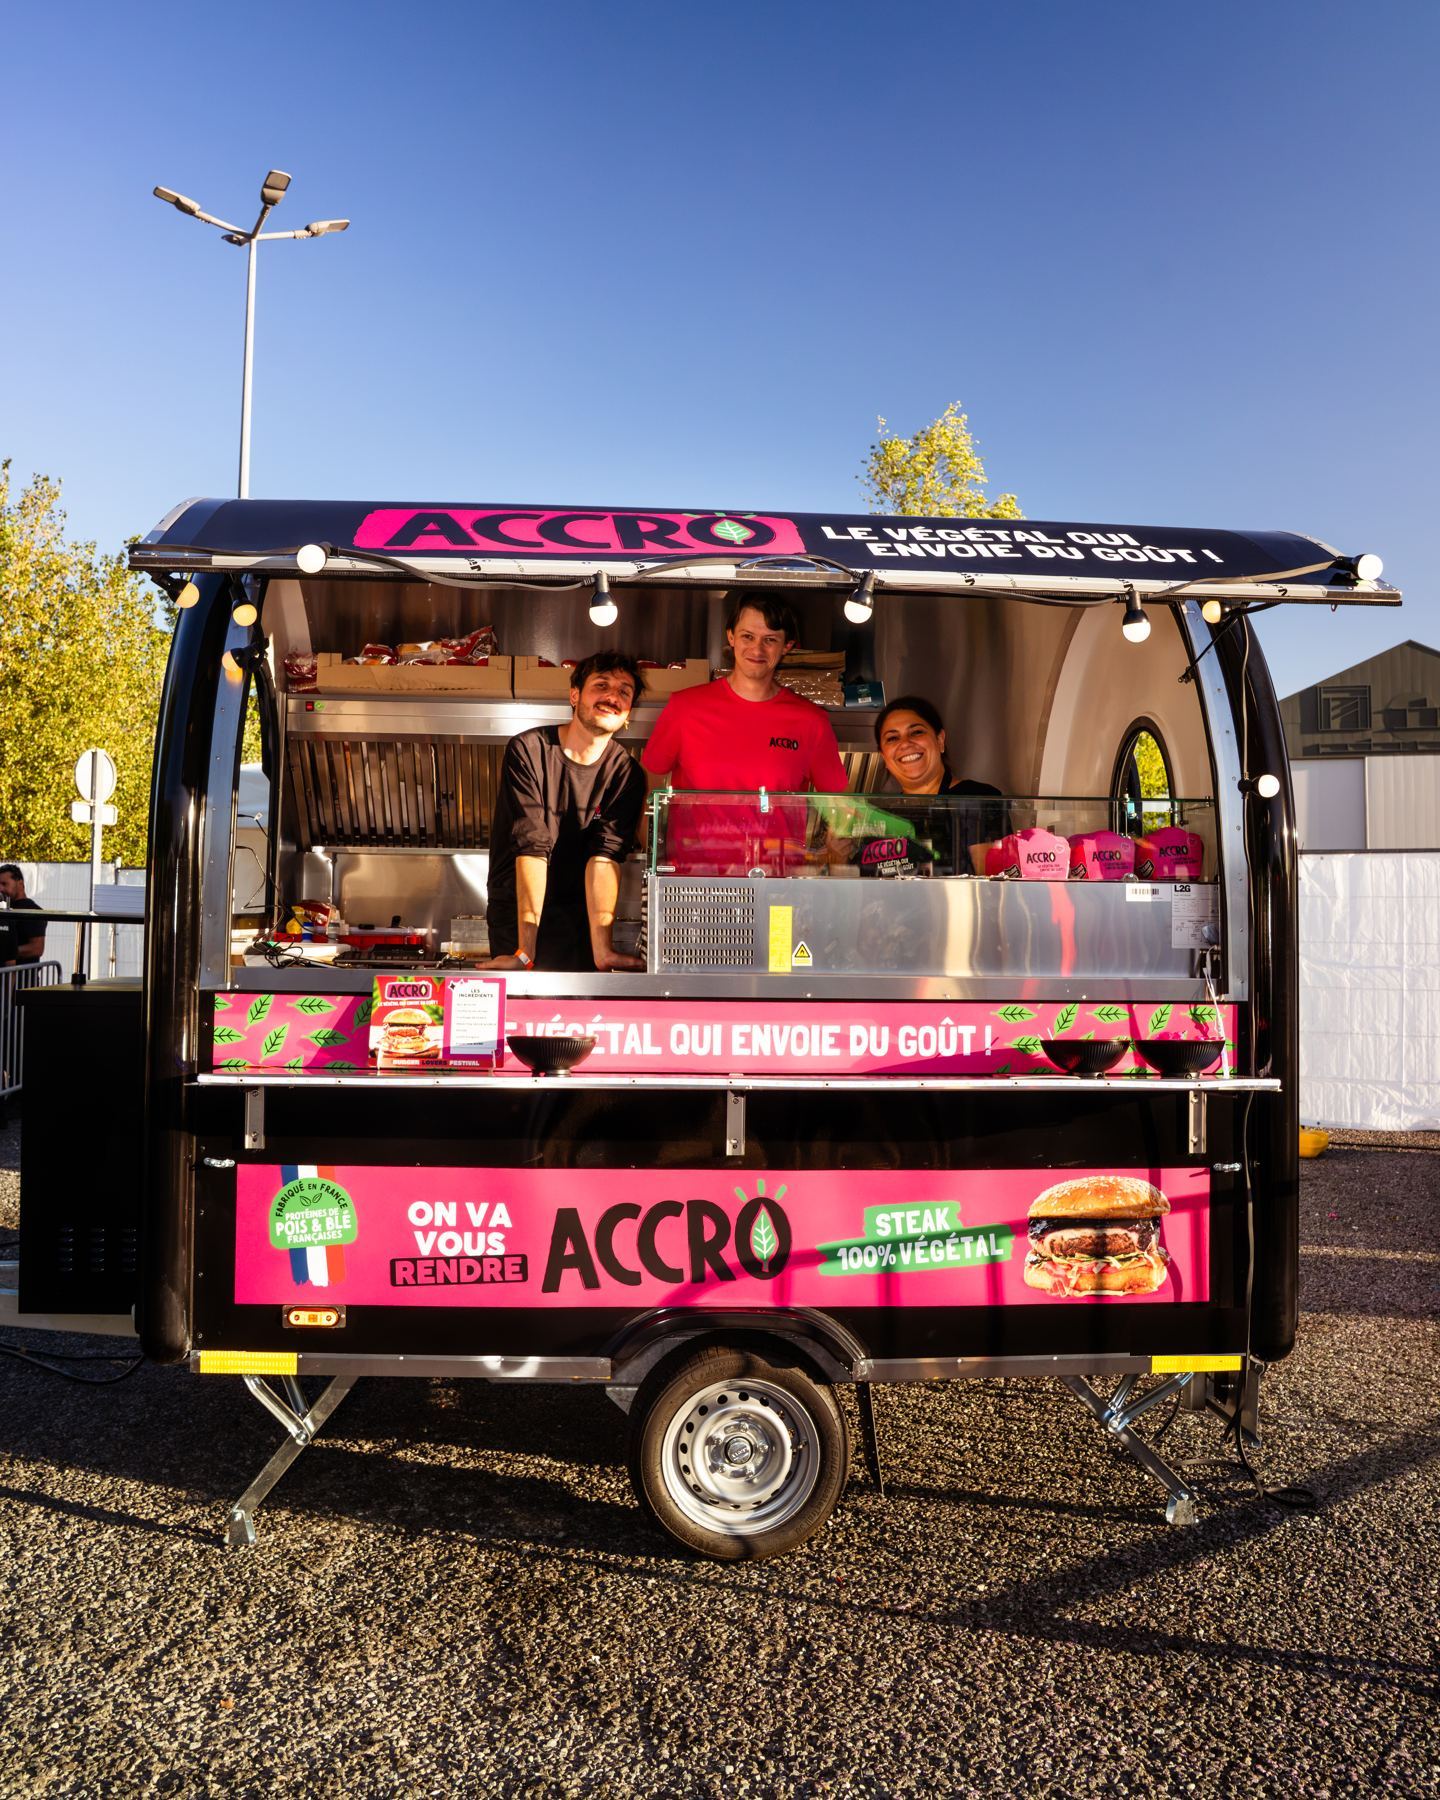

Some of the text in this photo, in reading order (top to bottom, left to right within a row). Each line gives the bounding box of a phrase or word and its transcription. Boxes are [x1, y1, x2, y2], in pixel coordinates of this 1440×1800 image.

[384, 512, 776, 550] ACCRO
[821, 526, 1141, 547] LE VÉGÉTAL QUI
[866, 542, 1225, 563] ENVOIE DU GOÛT !
[864, 839, 903, 863] ACCRO
[1026, 851, 1056, 864] ACCRO
[1092, 850, 1121, 862] ACCRO
[1160, 845, 1188, 857] ACCRO
[1174, 884, 1191, 893] L2G
[390, 984, 428, 998] ACCRO
[671, 1023, 722, 1056] QUI
[732, 1023, 840, 1057] ENVOIE
[850, 1023, 889, 1057] DU
[898, 1016, 976, 1057] GOÛT
[984, 1024, 992, 1056] !
[275, 1181, 305, 1217] FABRIQUÉ
[320, 1183, 348, 1209] FRANCE
[275, 1209, 352, 1236] POIS & BLÉ
[285, 1207, 339, 1221] PROTÉINES DE
[407, 1201, 513, 1229] ON VA
[875, 1207, 950, 1237] STEAK
[287, 1230, 343, 1244] FRANÇAISES
[414, 1230, 506, 1257] VOUS
[541, 1197, 792, 1293] ACCRO
[837, 1232, 1004, 1270] 100% VÉGÉTAL
[395, 1257, 524, 1285] RENDRE
